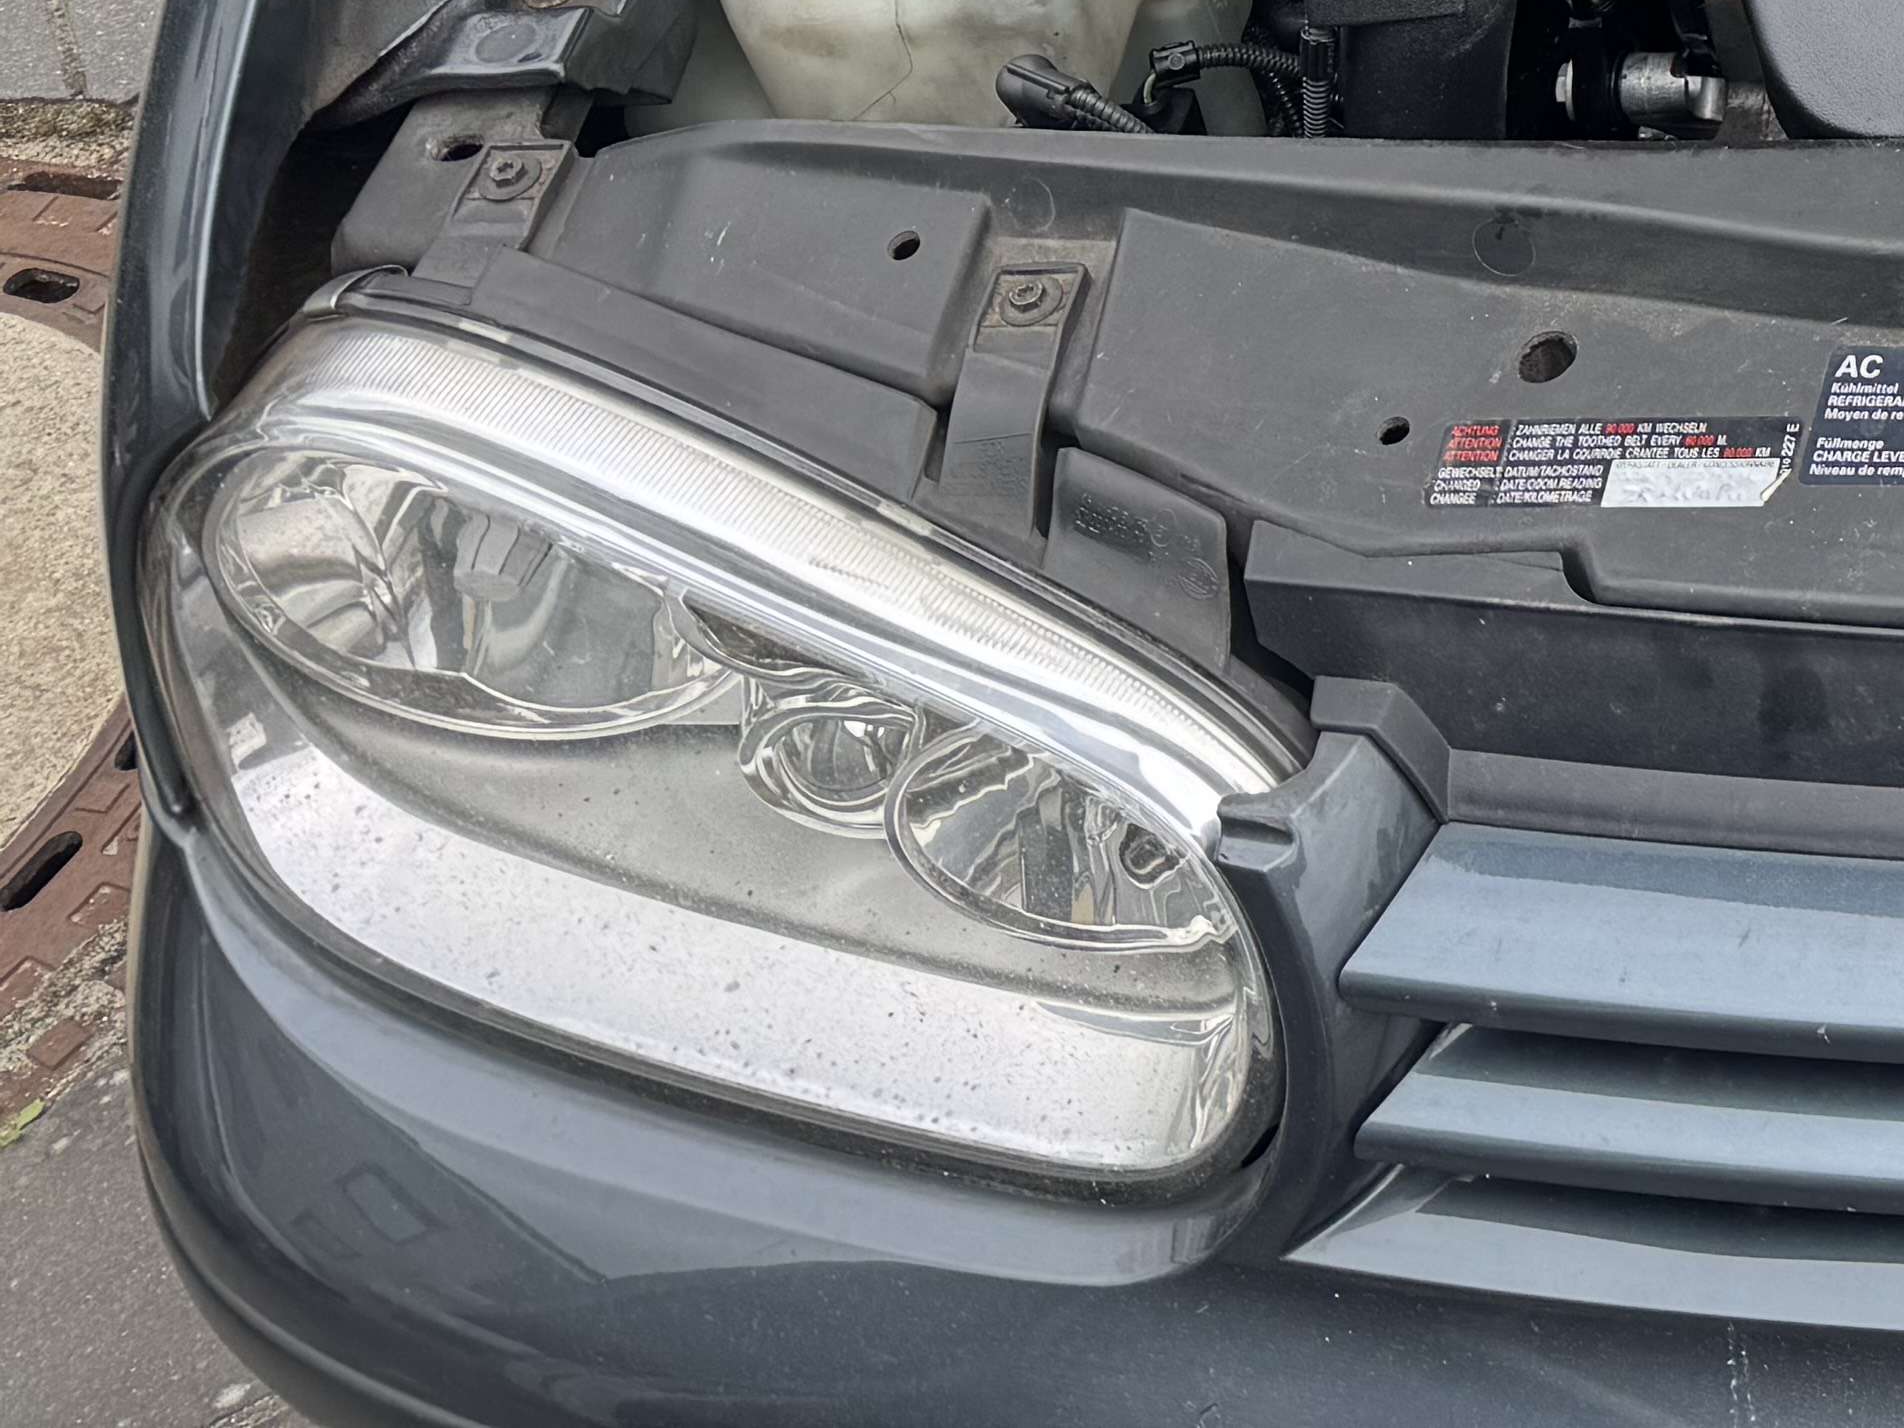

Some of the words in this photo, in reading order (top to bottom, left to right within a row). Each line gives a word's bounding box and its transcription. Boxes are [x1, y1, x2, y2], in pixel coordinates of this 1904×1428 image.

[1835, 354, 1884, 378] AC
[1831, 382, 1899, 394] Kühlmittel
[1824, 408, 1869, 421] Moyen
[1871, 408, 1888, 420] de
[1451, 425, 1499, 436] ACHTUNG
[1578, 423, 1603, 434] ALLE
[1637, 422, 1652, 433] KM
[1448, 438, 1502, 448] ATTENTION
[1513, 437, 1551, 448] CHANGE
[1555, 436, 1573, 447] THE
[1625, 436, 1647, 446] BELT
[1650, 435, 1681, 446] EVERY
[1816, 437, 1885, 452] Füllmenge
[1443, 450, 1499, 461] ATTENTION
[1509, 449, 1553, 461] CHANGER
[1557, 449, 1569, 459] LA
[1673, 447, 1698, 458] TOUS
[1701, 447, 1720, 457] LES
[1755, 447, 1771, 457] KM
[1812, 450, 1871, 462] CHARGE
[1809, 463, 1856, 476] Niveau
[1858, 464, 1875, 476] de
